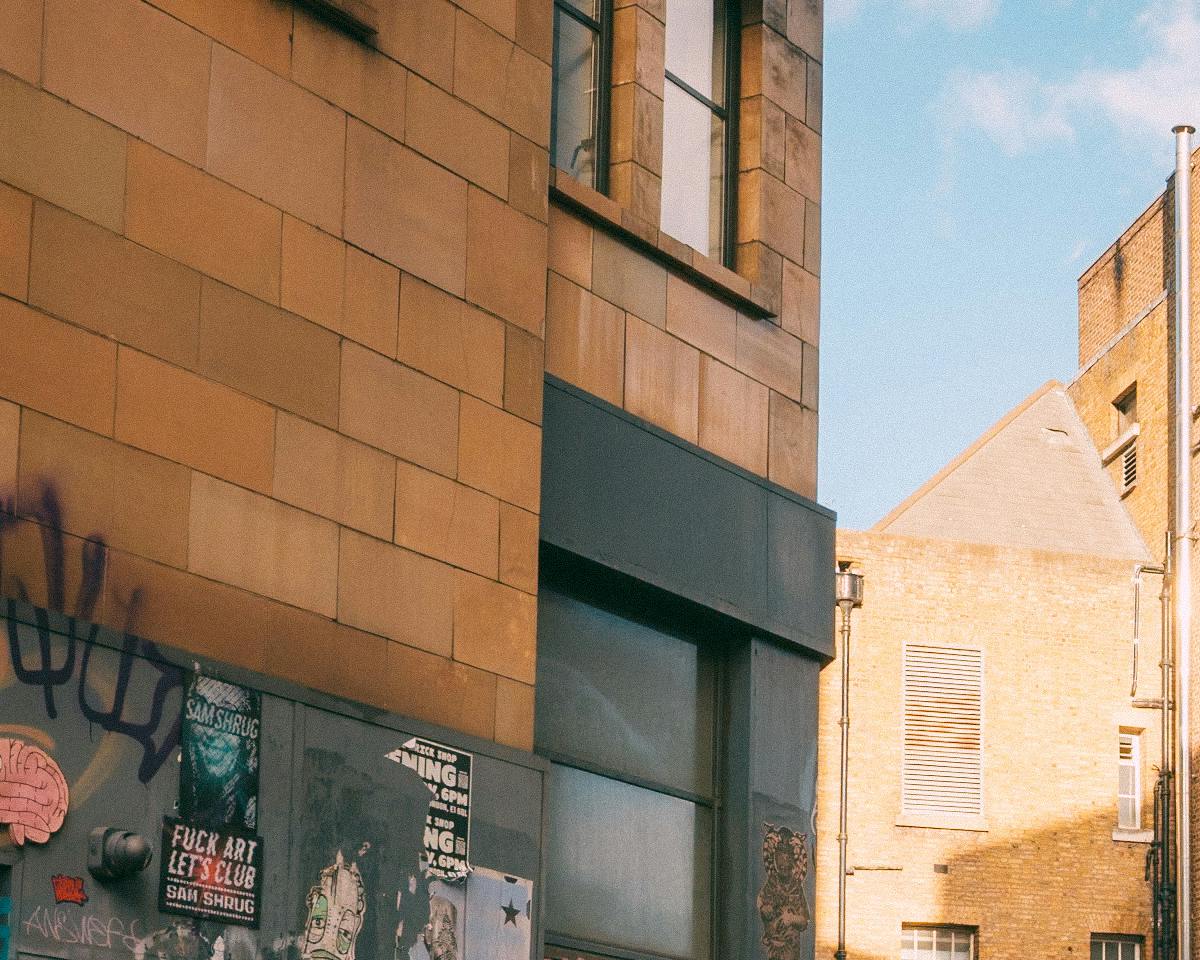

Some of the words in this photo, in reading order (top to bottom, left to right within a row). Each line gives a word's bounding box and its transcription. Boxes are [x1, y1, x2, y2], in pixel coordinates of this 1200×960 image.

[441, 787, 468, 807] 6PM
[171, 825, 217, 856] FUCK
[223, 836, 257, 866] ART
[168, 850, 211, 881] LET'S
[214, 860, 256, 890] CLUB
[166, 884, 198, 903] SAM
[203, 891, 255, 915] SHRUG
